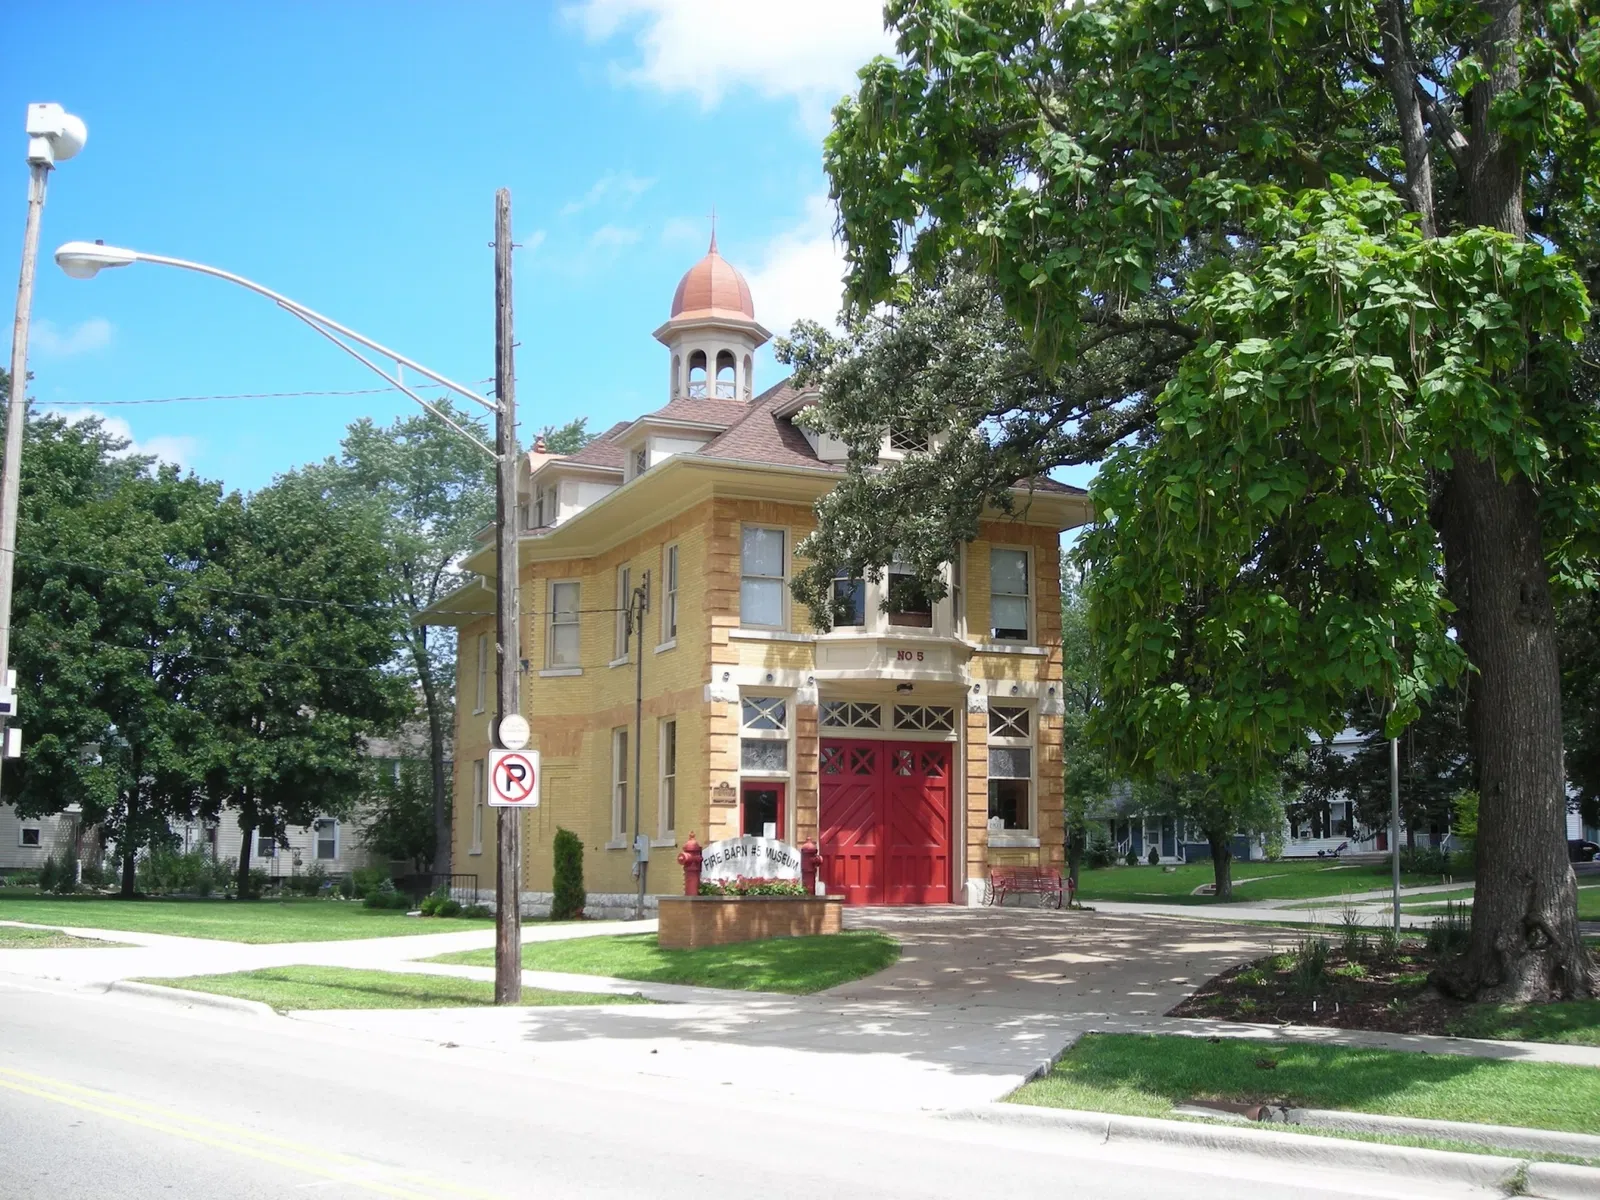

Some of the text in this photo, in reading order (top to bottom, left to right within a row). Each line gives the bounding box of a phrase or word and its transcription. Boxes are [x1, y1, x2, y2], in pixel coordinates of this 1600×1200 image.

[897, 650, 924, 662] NO 5
[506, 764, 526, 791] P
[703, 845, 799, 871] FIRE BARN #5 MUSEUM
